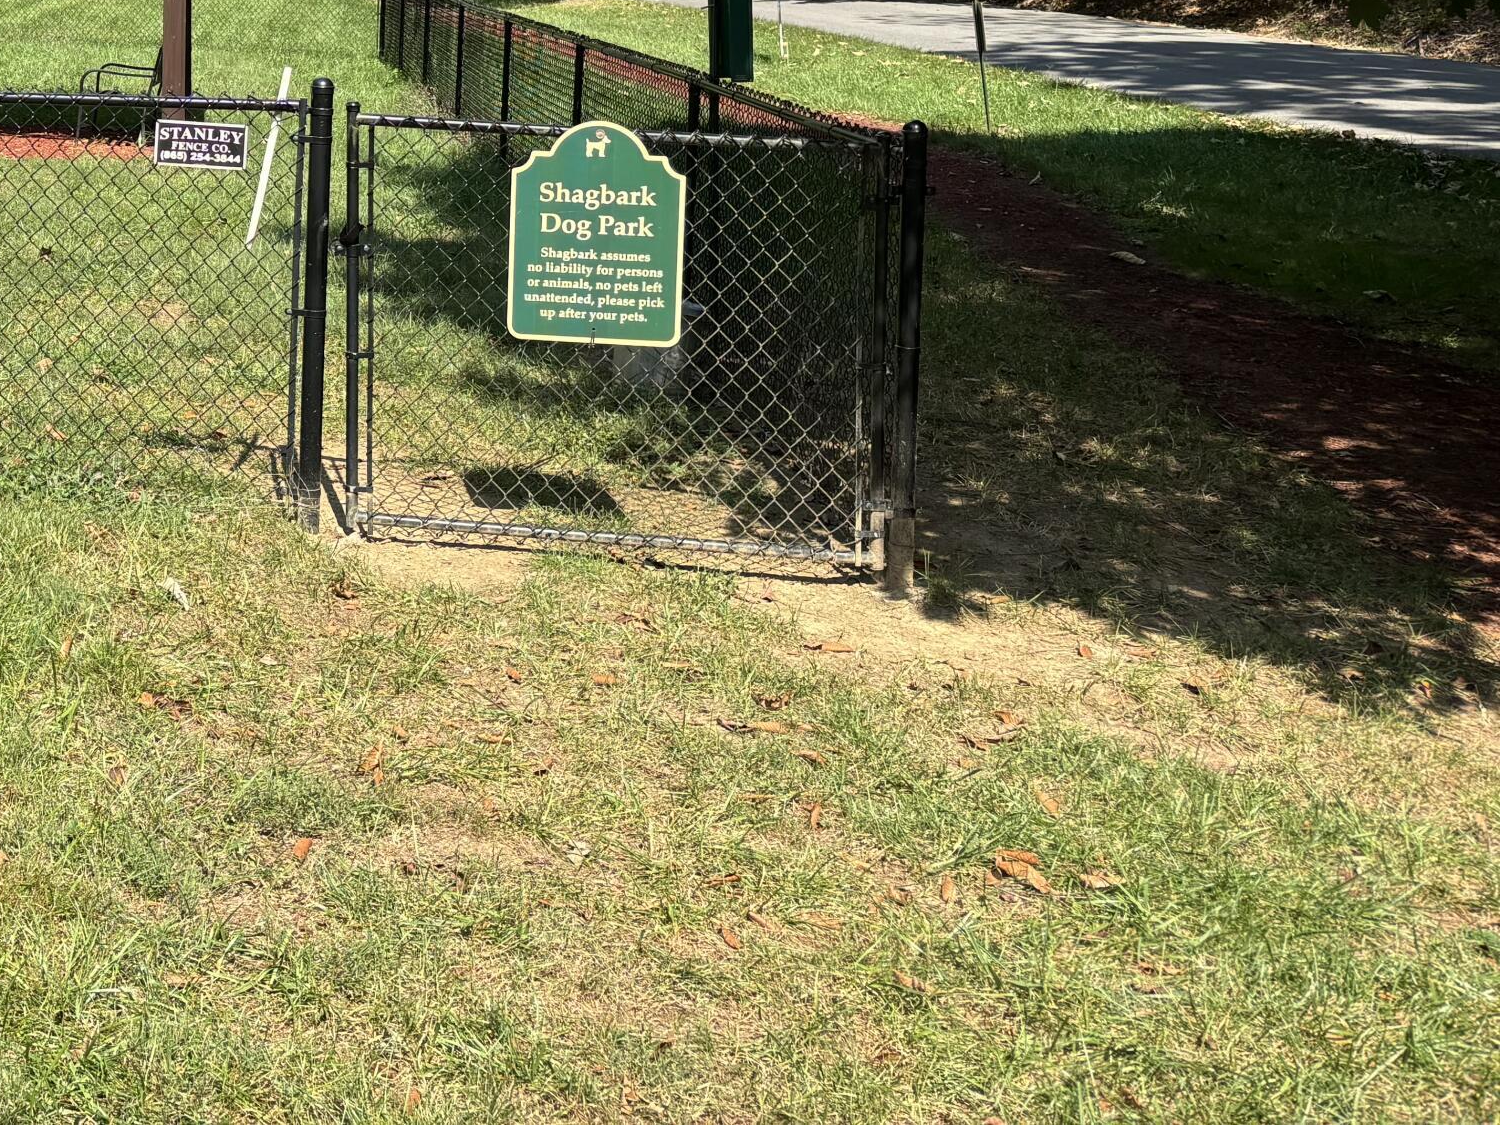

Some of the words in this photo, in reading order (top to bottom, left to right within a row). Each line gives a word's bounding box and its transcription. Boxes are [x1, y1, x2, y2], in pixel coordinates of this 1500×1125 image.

[160, 127, 243, 144] STANLEY
[171, 141, 208, 152] FENCE
[212, 144, 231, 153] CO.
[160, 150, 187, 162] (865)
[539, 182, 657, 210] Shagbark
[540, 213, 592, 240] Dog
[598, 215, 654, 237] Park
[540, 247, 597, 261] Shagbark
[600, 251, 650, 262] assumes
[528, 264, 542, 272] no
[546, 262, 593, 277] liability
[596, 265, 614, 275] for
[617, 268, 663, 280] persons
[527, 279, 539, 287] or
[542, 279, 592, 291] animals,
[596, 281, 611, 290] no
[614, 281, 638, 293] pets
[642, 282, 663, 293] left
[524, 293, 594, 306] unattended,
[598, 297, 635, 309] please
[639, 298, 665, 310] pick
[540, 309, 555, 319] up
[559, 308, 587, 319] after
[589, 312, 617, 323] your
[620, 312, 648, 323] pets.
